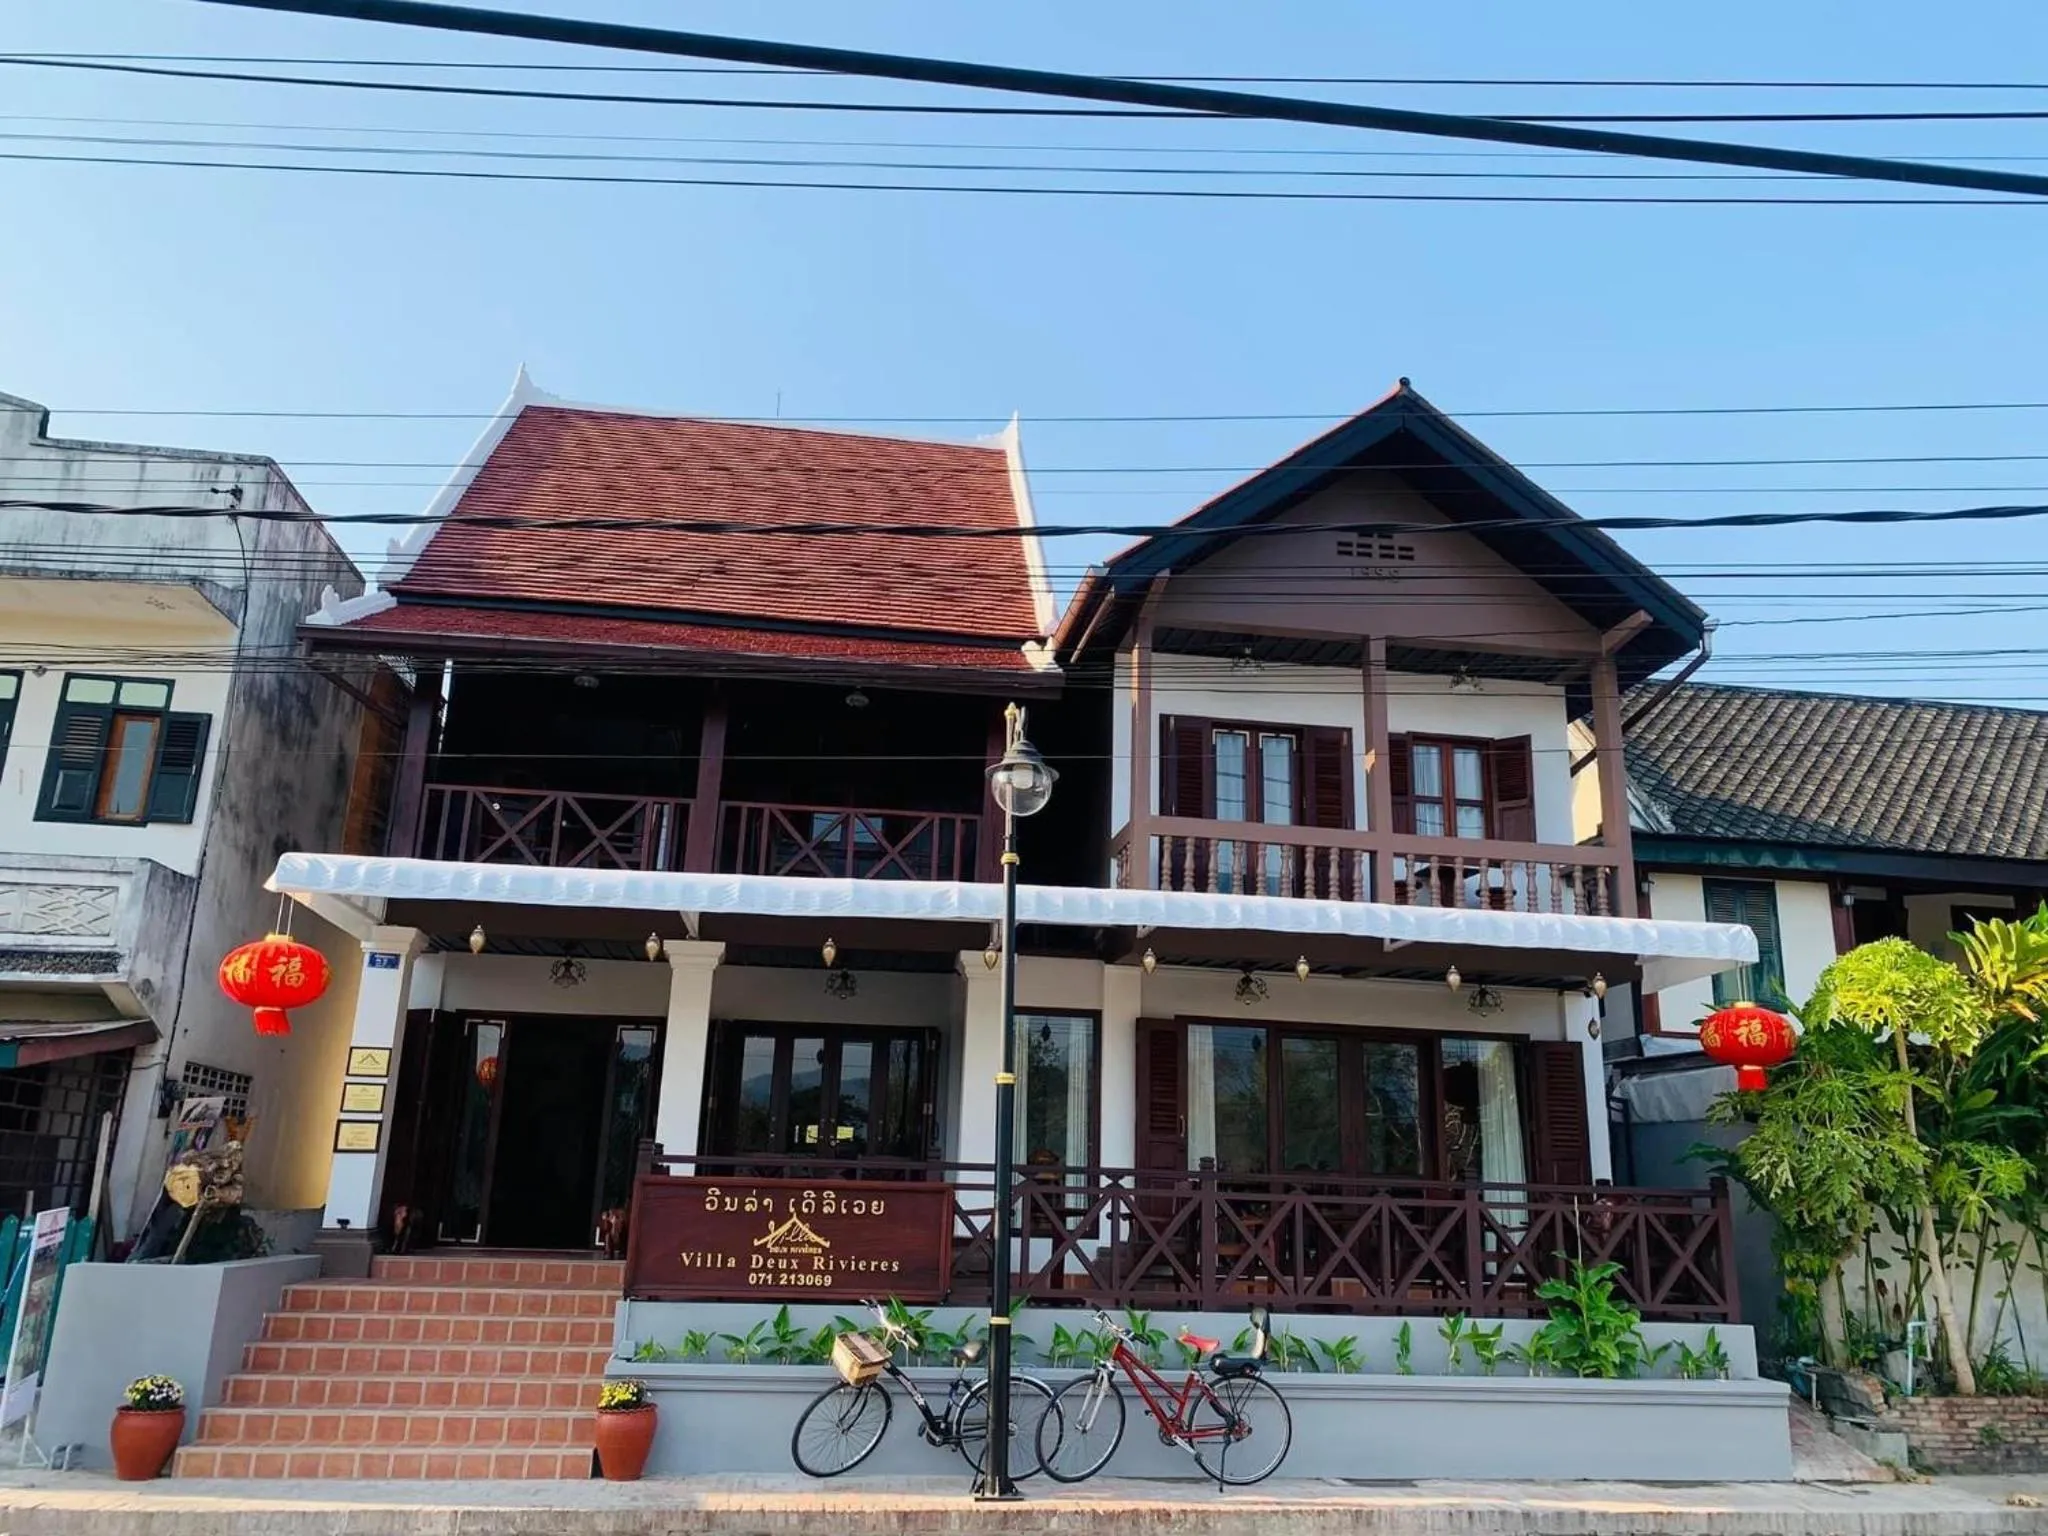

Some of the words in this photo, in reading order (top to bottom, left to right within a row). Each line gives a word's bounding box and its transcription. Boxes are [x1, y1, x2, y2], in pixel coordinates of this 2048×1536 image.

[269, 955, 305, 988] 福
[1733, 1017, 1768, 1047] 福
[681, 1252, 737, 1268] Villa
[750, 1254, 800, 1270] Deux
[813, 1255, 900, 1272] Rivieres
